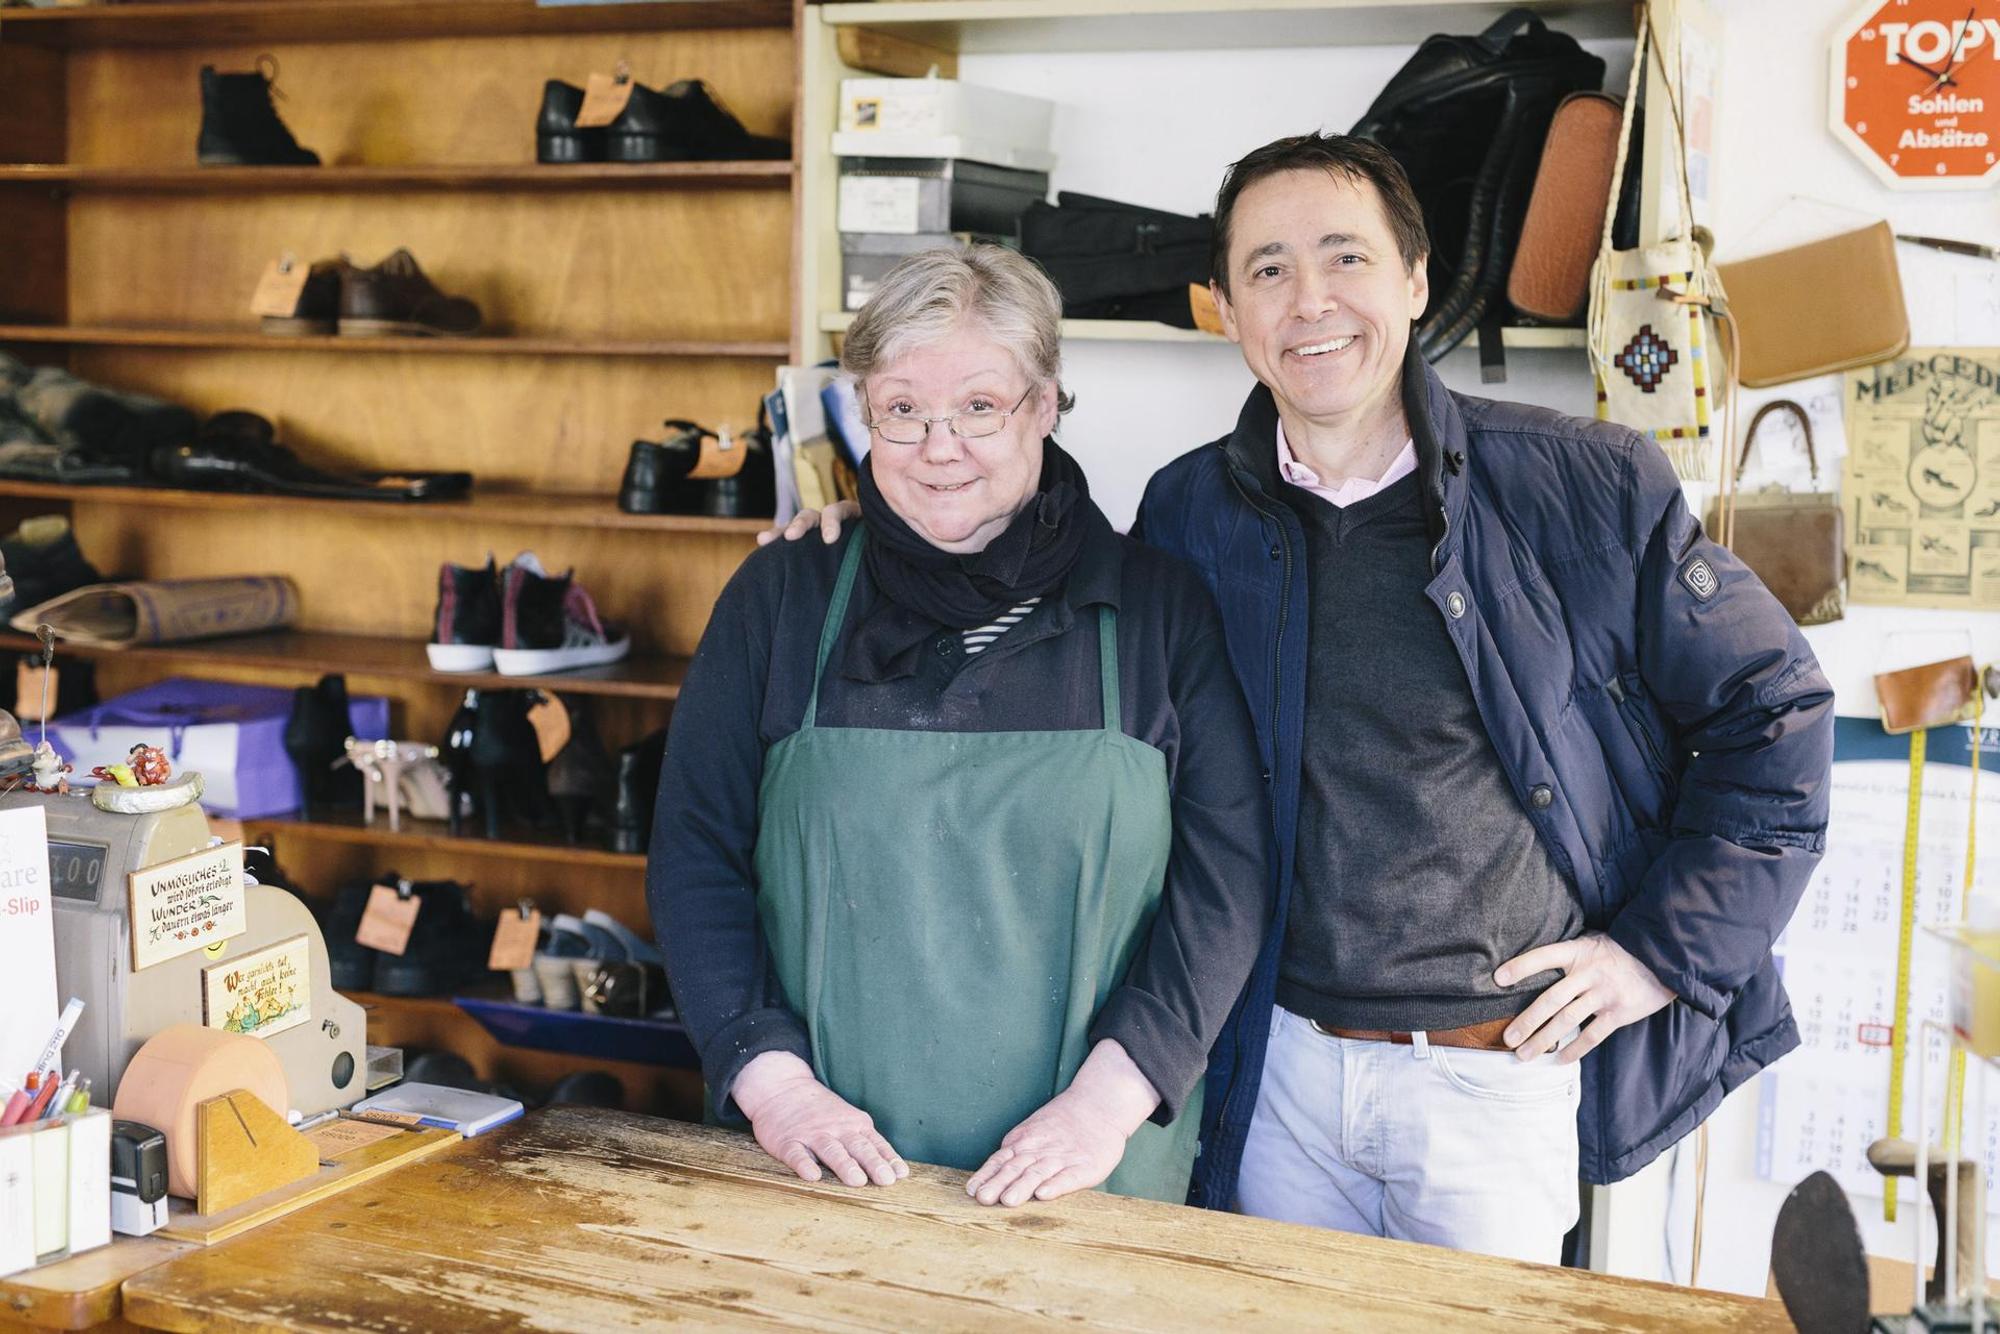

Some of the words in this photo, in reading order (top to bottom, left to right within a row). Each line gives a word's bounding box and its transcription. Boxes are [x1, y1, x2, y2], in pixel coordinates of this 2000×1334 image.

[1860, 28, 1876, 41] 10
[1908, 93, 1984, 115] Sohlen
[1934, 115, 1959, 128] und
[1898, 128, 1989, 149] Absätze
[167, 889, 185, 904] wird
[206, 875, 232, 894] erledigt
[151, 900, 197, 922] WUNDER
[161, 915, 190, 933] dauern
[190, 908, 211, 923] etwas
[211, 901, 233, 916] länger
[224, 970, 245, 993] Wer
